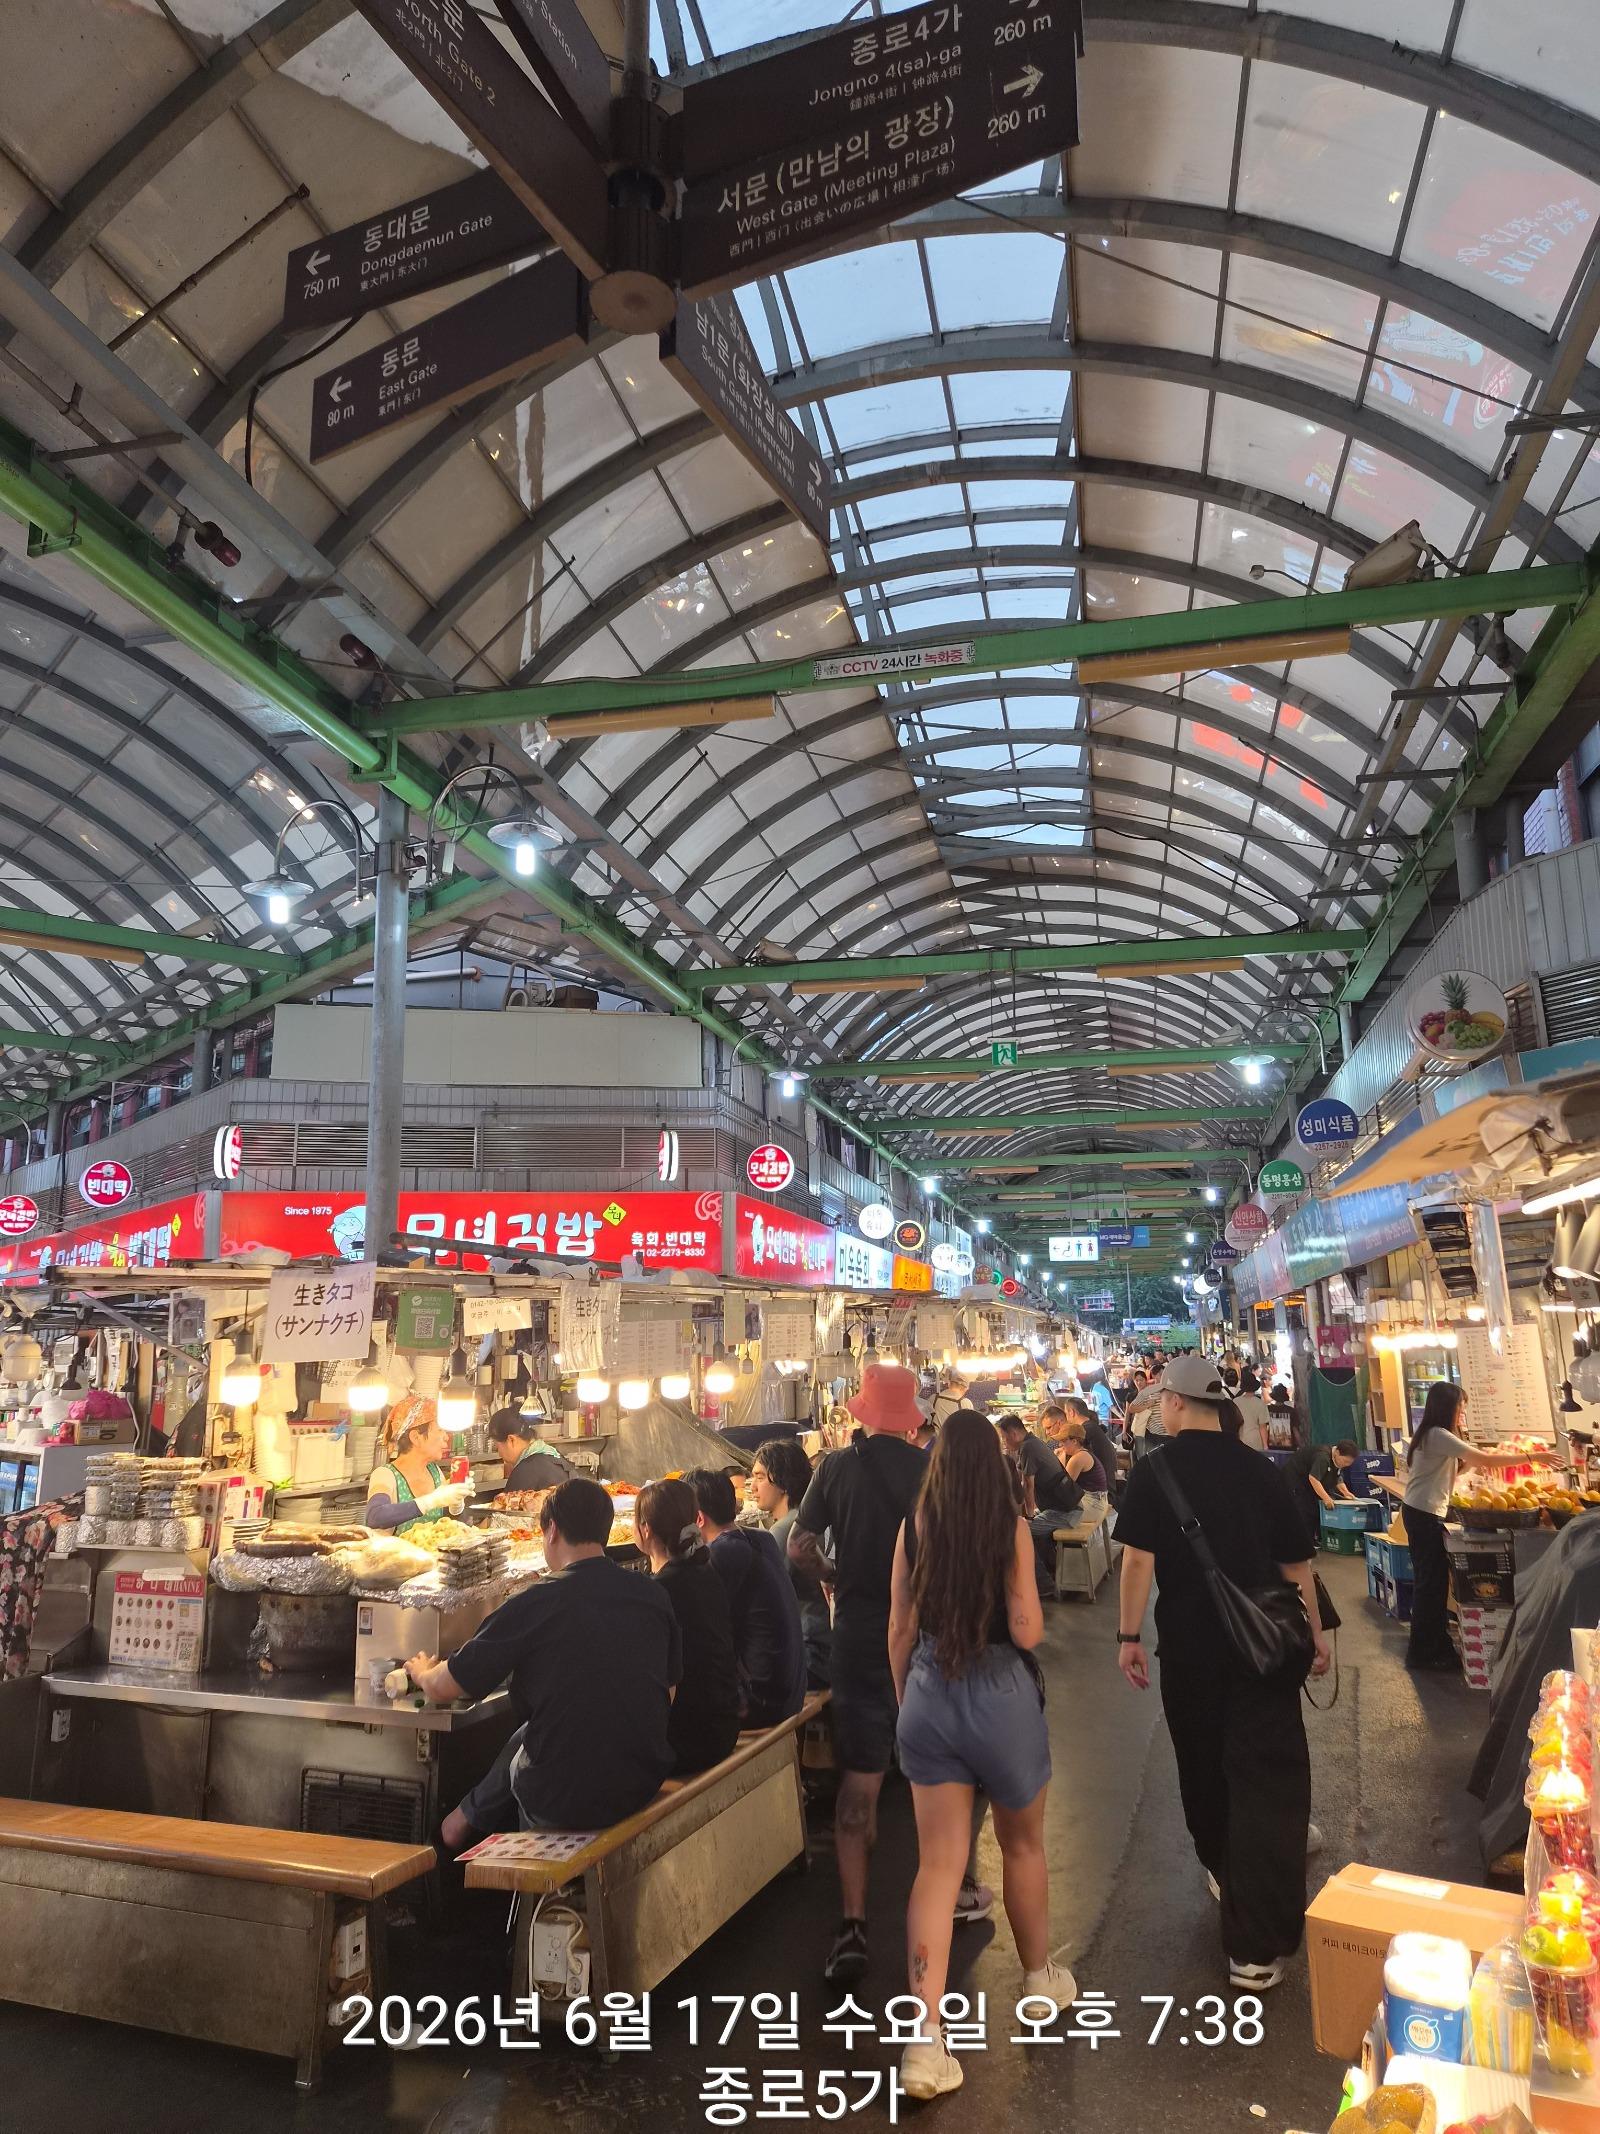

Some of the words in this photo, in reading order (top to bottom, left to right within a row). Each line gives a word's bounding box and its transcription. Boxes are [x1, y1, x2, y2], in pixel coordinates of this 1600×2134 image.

[540, 0, 578, 69] Station
[850, 3, 963, 67] 종로4가
[993, 21, 1026, 47] 260
[1034, 15, 1052, 32] m
[404, 0, 442, 44] orth
[448, 41, 483, 90] Gate
[486, 87, 496, 107] 2
[808, 74, 879, 106] Jongno
[885, 43, 962, 80] 4(sa)-ga
[885, 95, 955, 150] 광장)
[987, 115, 1020, 140] 260
[1027, 104, 1047, 121] m
[737, 205, 775, 236] West
[781, 193, 818, 219] Gate
[823, 161, 899, 203] (Meeting
[904, 136, 956, 170] Plaza)
[360, 230, 454, 276] Dongdaemun
[459, 214, 493, 237] Gate
[363, 204, 431, 253] 동대문
[303, 278, 324, 300] 750
[327, 274, 340, 289] m
[380, 336, 421, 377] 동문
[378, 378, 405, 400] East
[408, 362, 438, 385] Gate
[701, 344, 727, 385] South
[728, 381, 748, 413] Gate
[327, 409, 341, 427] 80
[343, 404, 355, 417] m
[842, 659, 879, 674] CCTV
[881, 654, 922, 670] 24시간
[924, 649, 963, 664] 녹화중
[1301, 1114, 1355, 1137] 성미식품
[749, 1161, 789, 1175] 모녀김밥
[284, 1206, 310, 1216] Since
[311, 1206, 333, 1215] 1975
[405, 1211, 603, 1269] 모녀김밥
[631, 1230, 706, 1247] 육회.빈대떡
[646, 1248, 706, 1257] 02-2273-8330
[293, 1282, 354, 1307] 生きタコ
[275, 1308, 365, 1340] (サンナクチ)
[1321, 1937, 1339, 1949] 커피
